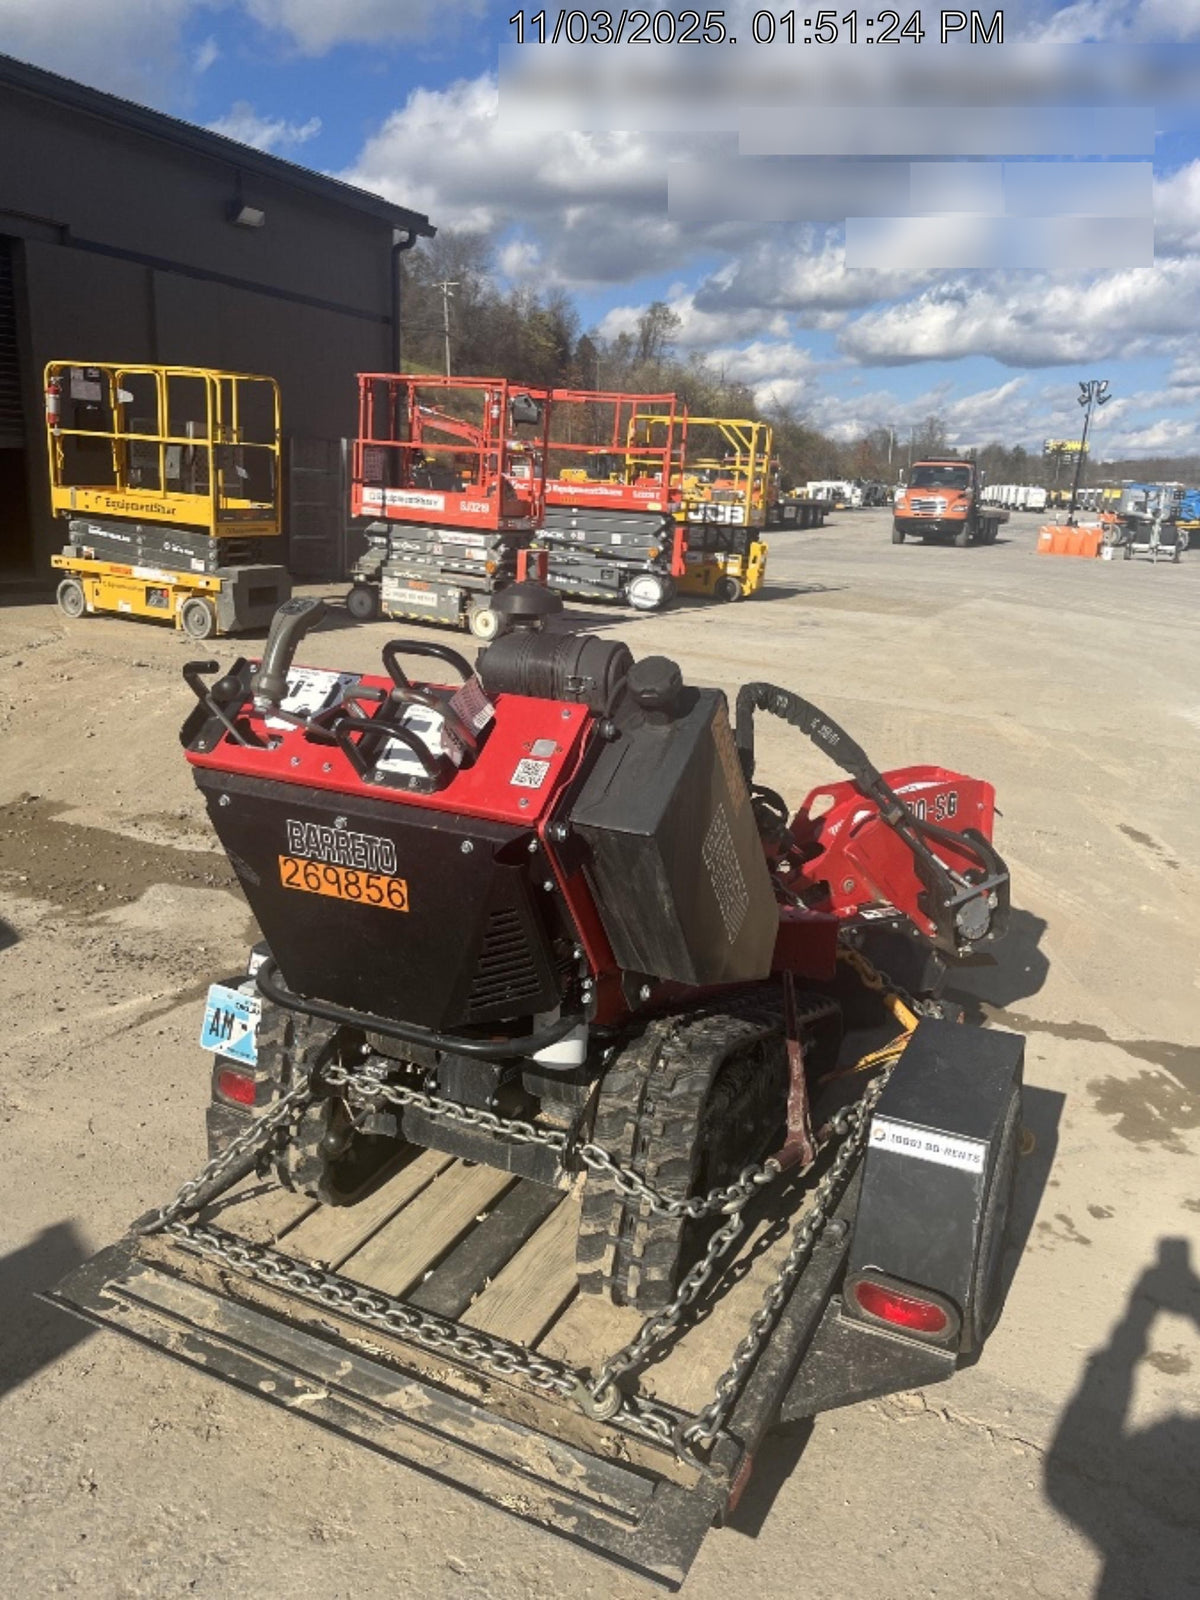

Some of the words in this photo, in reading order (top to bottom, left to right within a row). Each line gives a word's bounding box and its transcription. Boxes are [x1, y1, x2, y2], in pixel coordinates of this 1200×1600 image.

[688, 504, 744, 524] JCB
[286, 819, 398, 875] BARRETO
[283, 858, 406, 910] 269856
